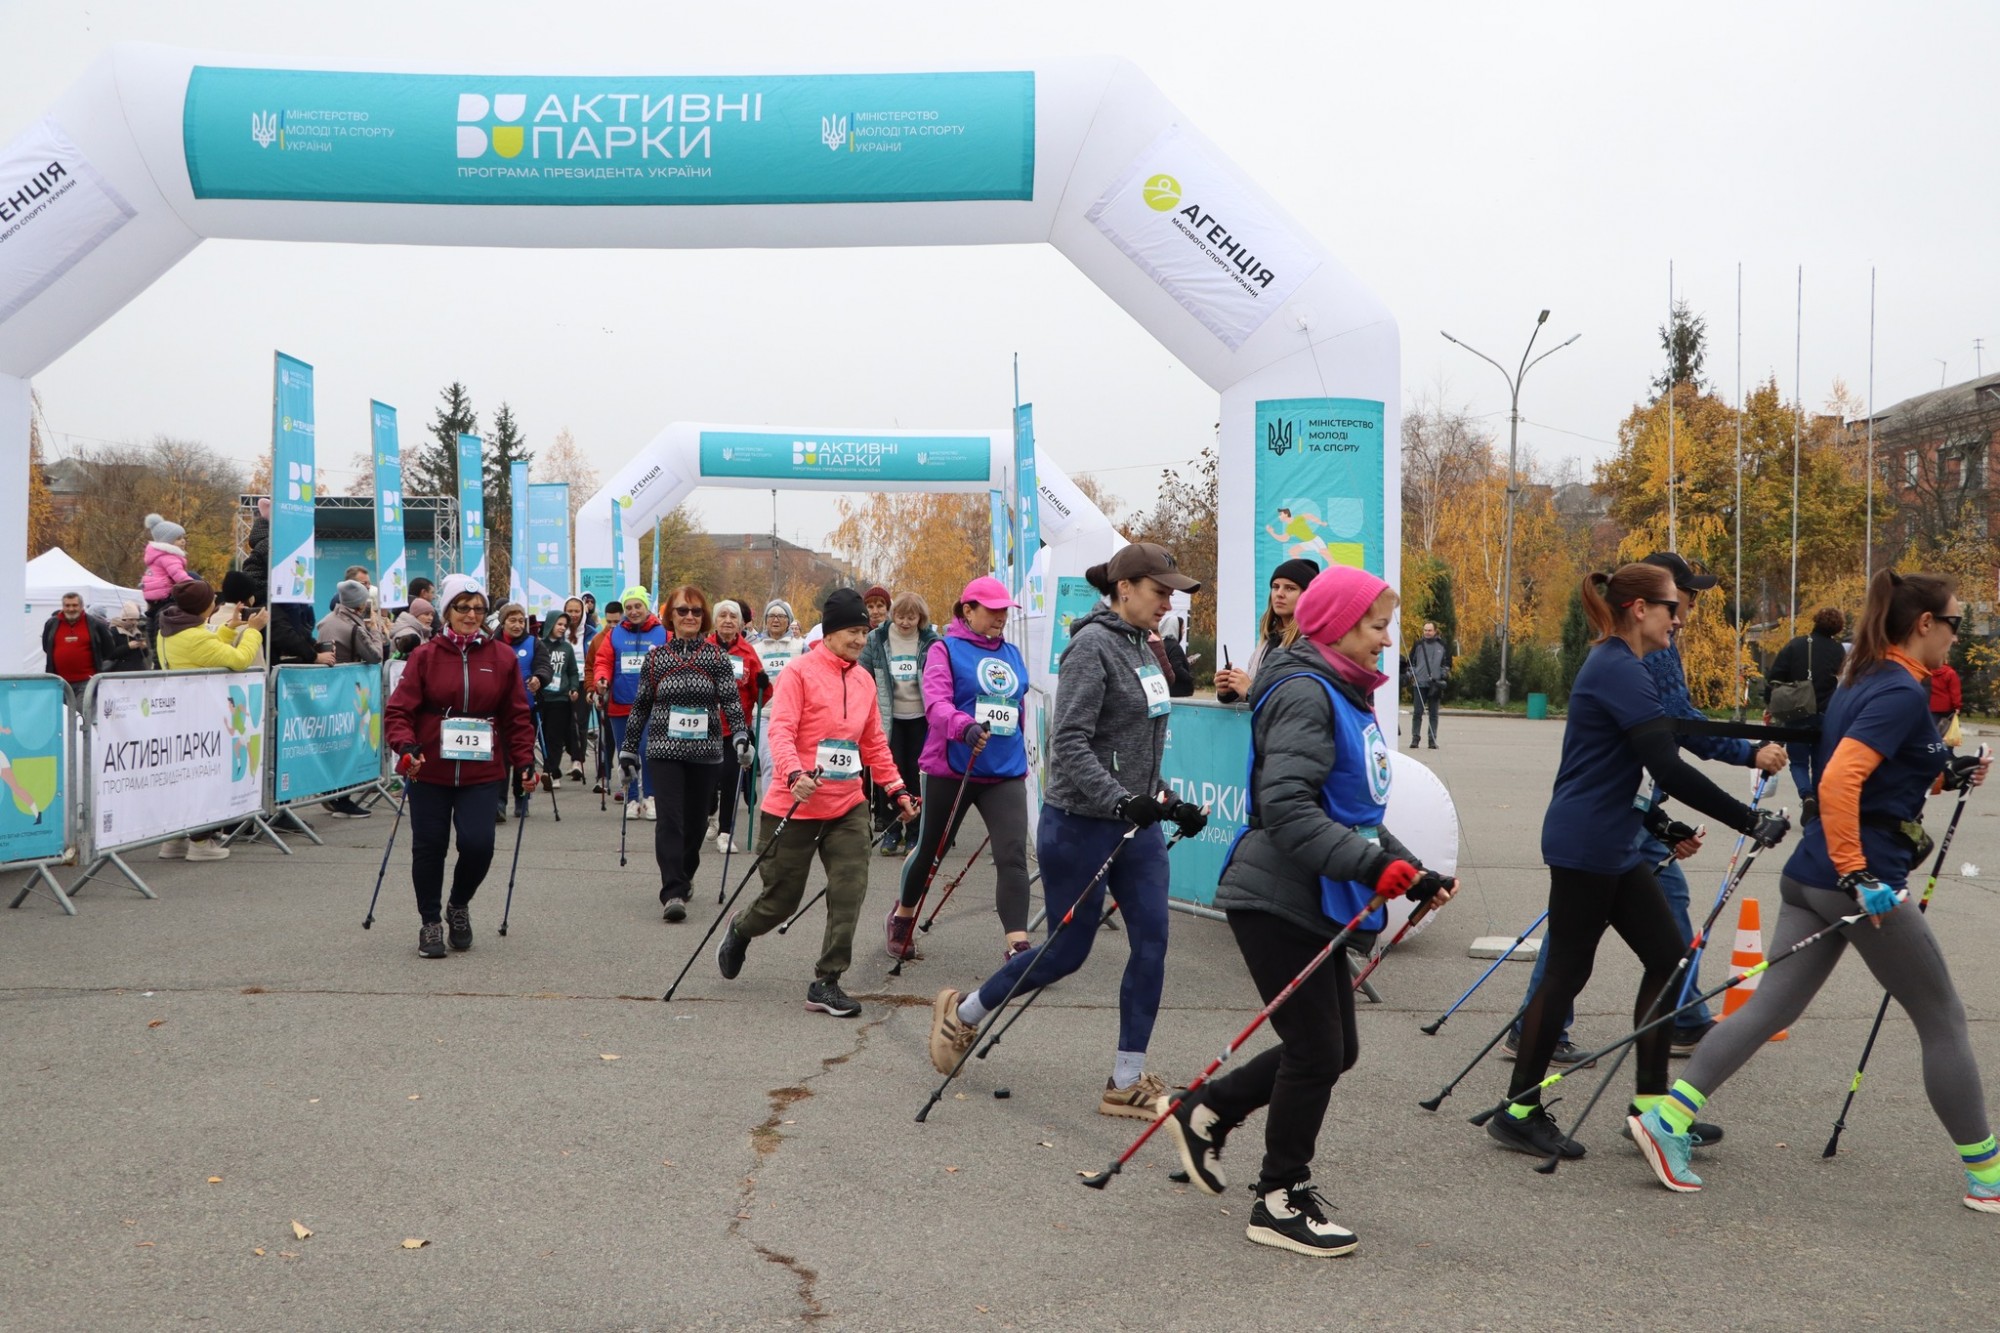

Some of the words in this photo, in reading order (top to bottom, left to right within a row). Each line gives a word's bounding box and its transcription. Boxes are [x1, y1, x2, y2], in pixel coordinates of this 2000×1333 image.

[533, 92, 763, 123] АКТИВНІ
[285, 110, 370, 122] МІНІСТЕРСТВО
[855, 110, 940, 122] МІНІСТЕРСТВО
[285, 125, 331, 137] МОЛОДІ
[333, 126, 347, 137] ТА
[349, 127, 396, 138] СПОРТУ
[855, 126, 900, 138] МОЛОДІ
[902, 126, 917, 137] ТА
[919, 125, 966, 137] СПОРТУ
[285, 140, 332, 152] УКРАЇНИ
[531, 125, 711, 159] ПАРКИ
[855, 142, 902, 153] УКРАЇНИ
[457, 166, 540, 178] ПРОГРАМА
[543, 167, 644, 179] ПРЕЗИДЕНТА
[648, 164, 712, 178] УКРАЇНИ
[46, 179, 78, 206] УКРАЇНИ
[1179, 203, 1276, 289] АГЕНЦІЯ
[1171, 217, 1207, 251] МАСОВОГО
[1205, 248, 1232, 273] СПОРТУ
[1230, 269, 1260, 299] УКРАЇНИ
[1308, 419, 1374, 430] МІНІСТЕРСТВО
[1308, 431, 1349, 442] МОЛОДІ
[819, 441, 898, 455] АКТИВНІ
[1308, 444, 1321, 452] ТА
[1323, 444, 1360, 453] СПОРТУ
[818, 453, 882, 467] ПАРКИ
[629, 464, 662, 497] АГЕНЦІЯ
[1039, 485, 1072, 517] АГЕНЦІЯ
[548, 651, 567, 661] AVE
[769, 660, 785, 668] 434
[898, 663, 913, 671] 420
[987, 709, 1010, 722] 406
[679, 718, 699, 728] 419
[455, 735, 480, 746] 413
[103, 738, 173, 774] АКТИВНІ
[174, 730, 222, 764] ПАРКИ
[829, 753, 852, 767] 439
[102, 776, 149, 796] ПРОГРАМА
[775, 817, 788, 836] LEKI
[1941, 825, 1956, 854] LEKI
